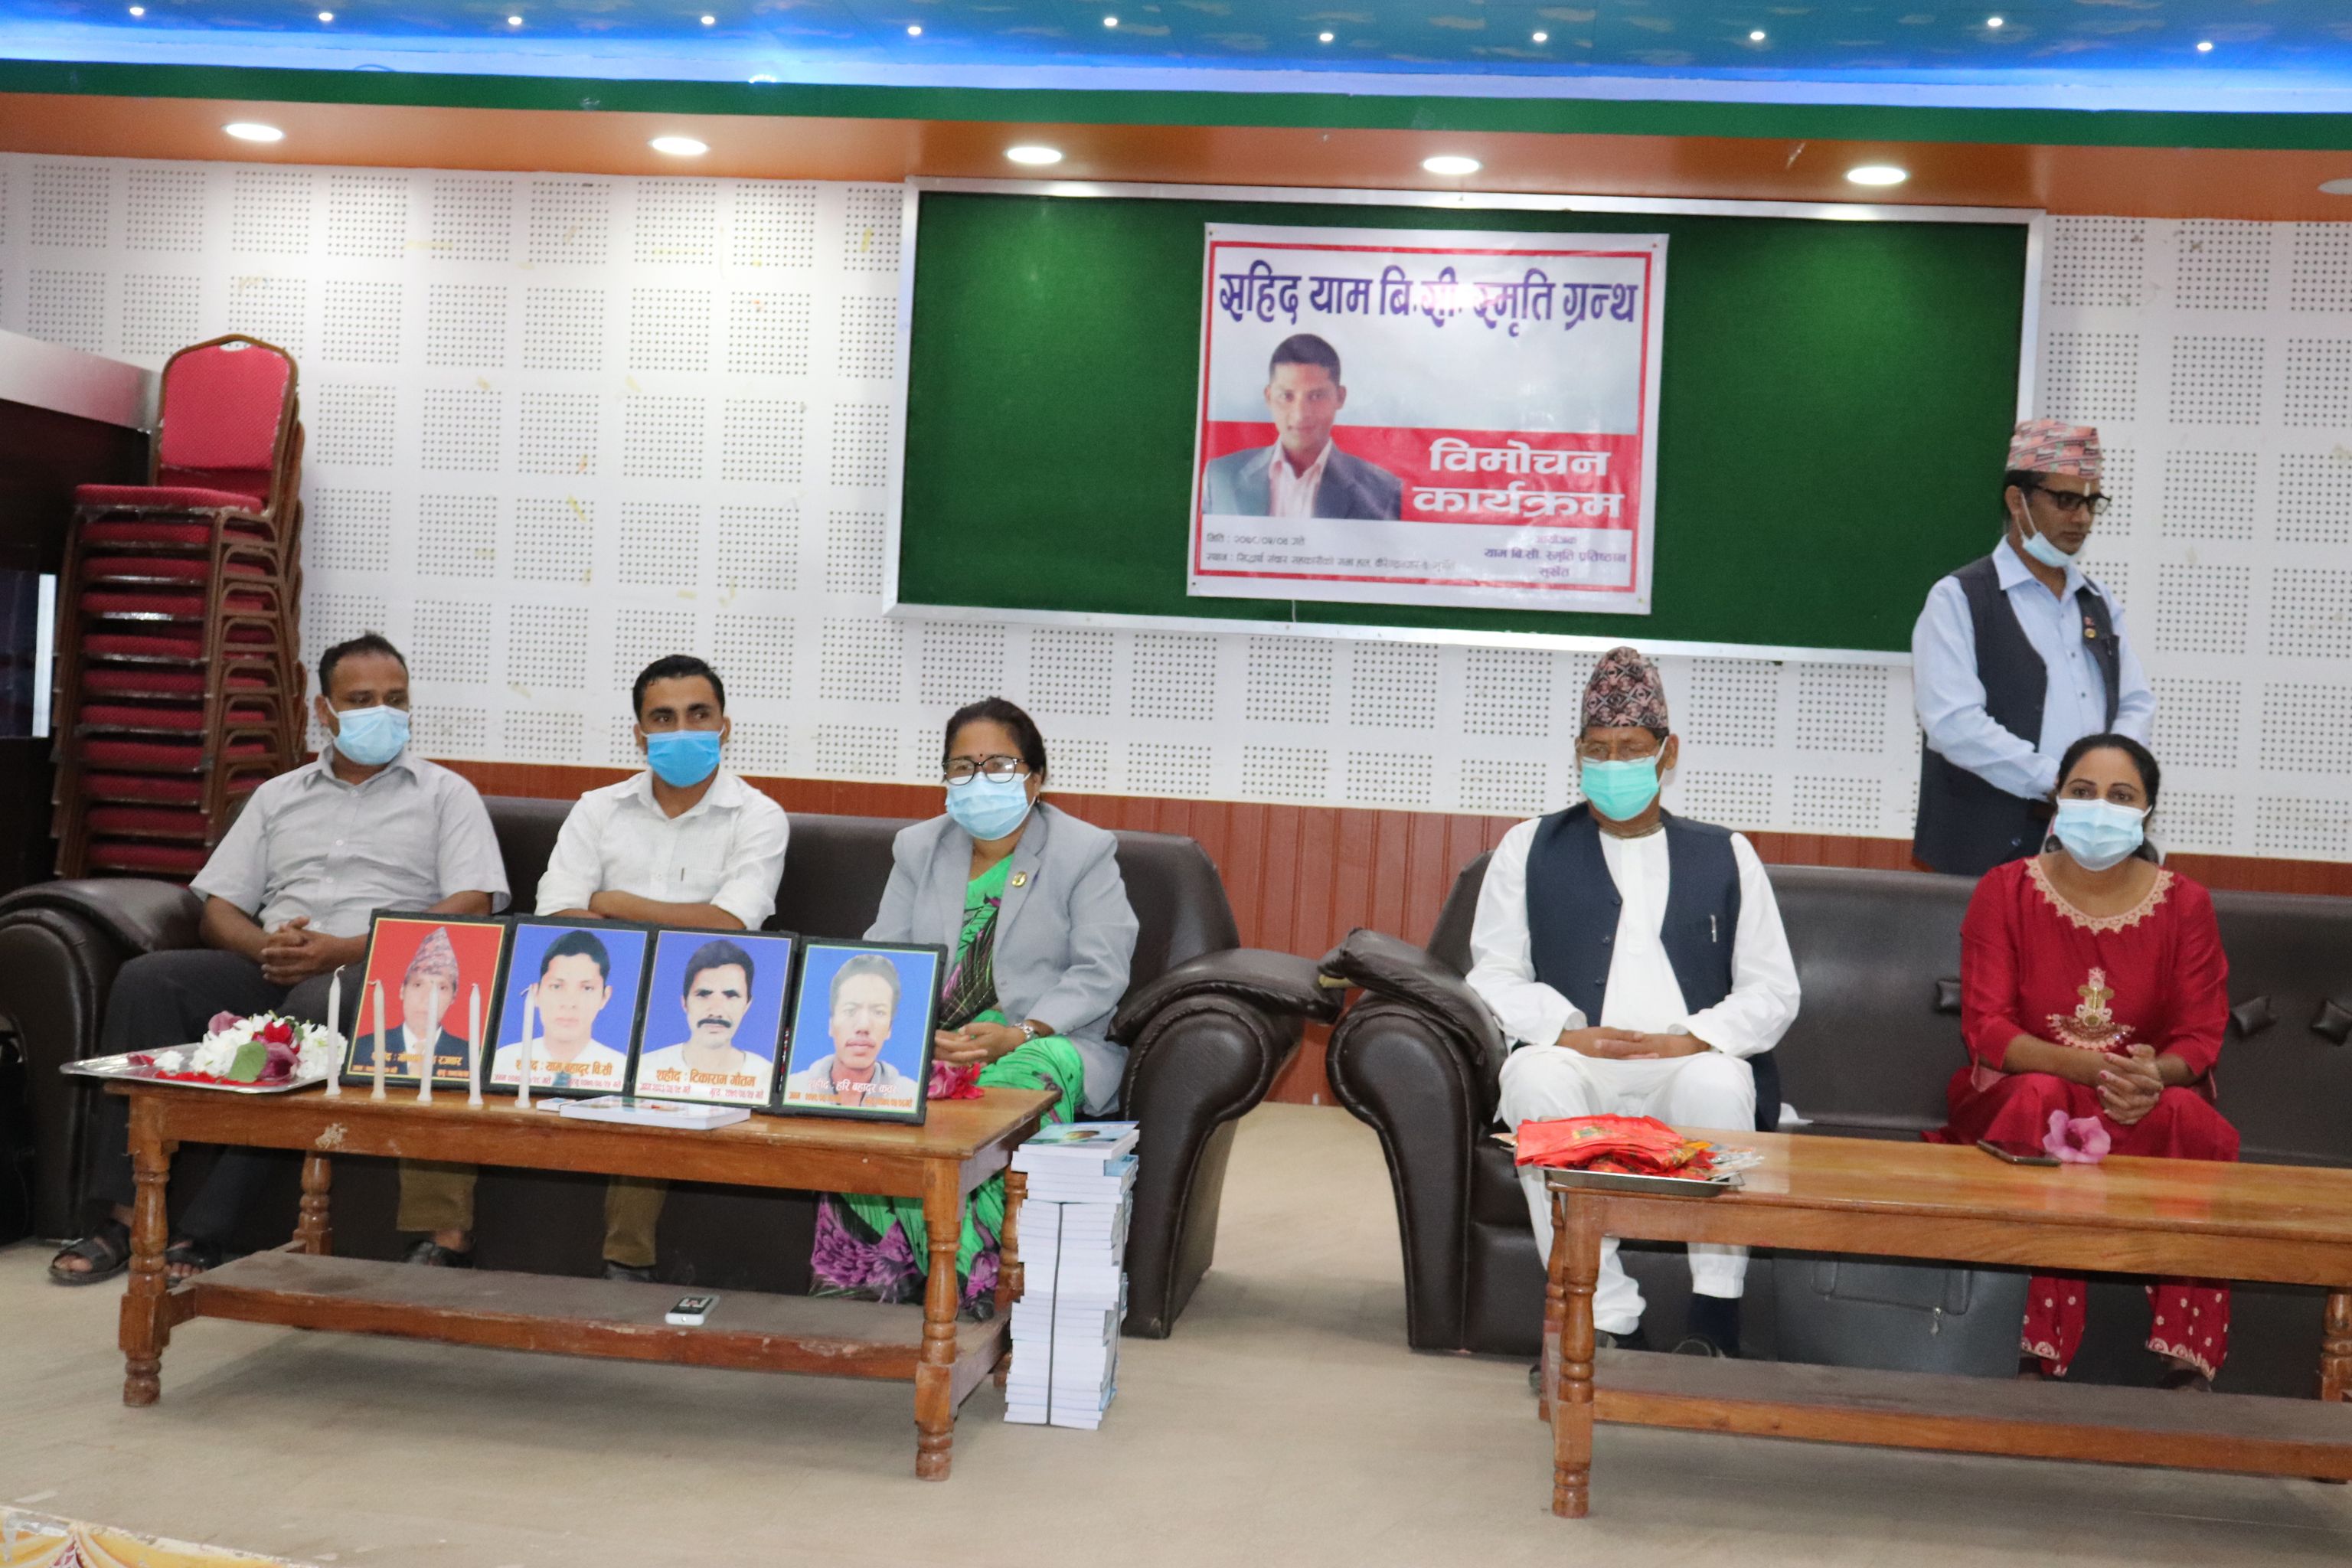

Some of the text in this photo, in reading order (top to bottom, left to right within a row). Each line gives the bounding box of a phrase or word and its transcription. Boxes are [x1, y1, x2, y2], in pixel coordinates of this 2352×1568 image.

[1220, 260, 1302, 325] सहिद
[1308, 274, 1373, 315] याम
[1473, 267, 1556, 337] स्मृति
[1562, 281, 1638, 331] ग्रन्थ
[1429, 436, 1612, 476] विमोचन
[1412, 480, 1625, 518] कार्यक्रम
[689, 1068, 728, 1086] टिकाराम
[836, 1078, 852, 1091] हरि
